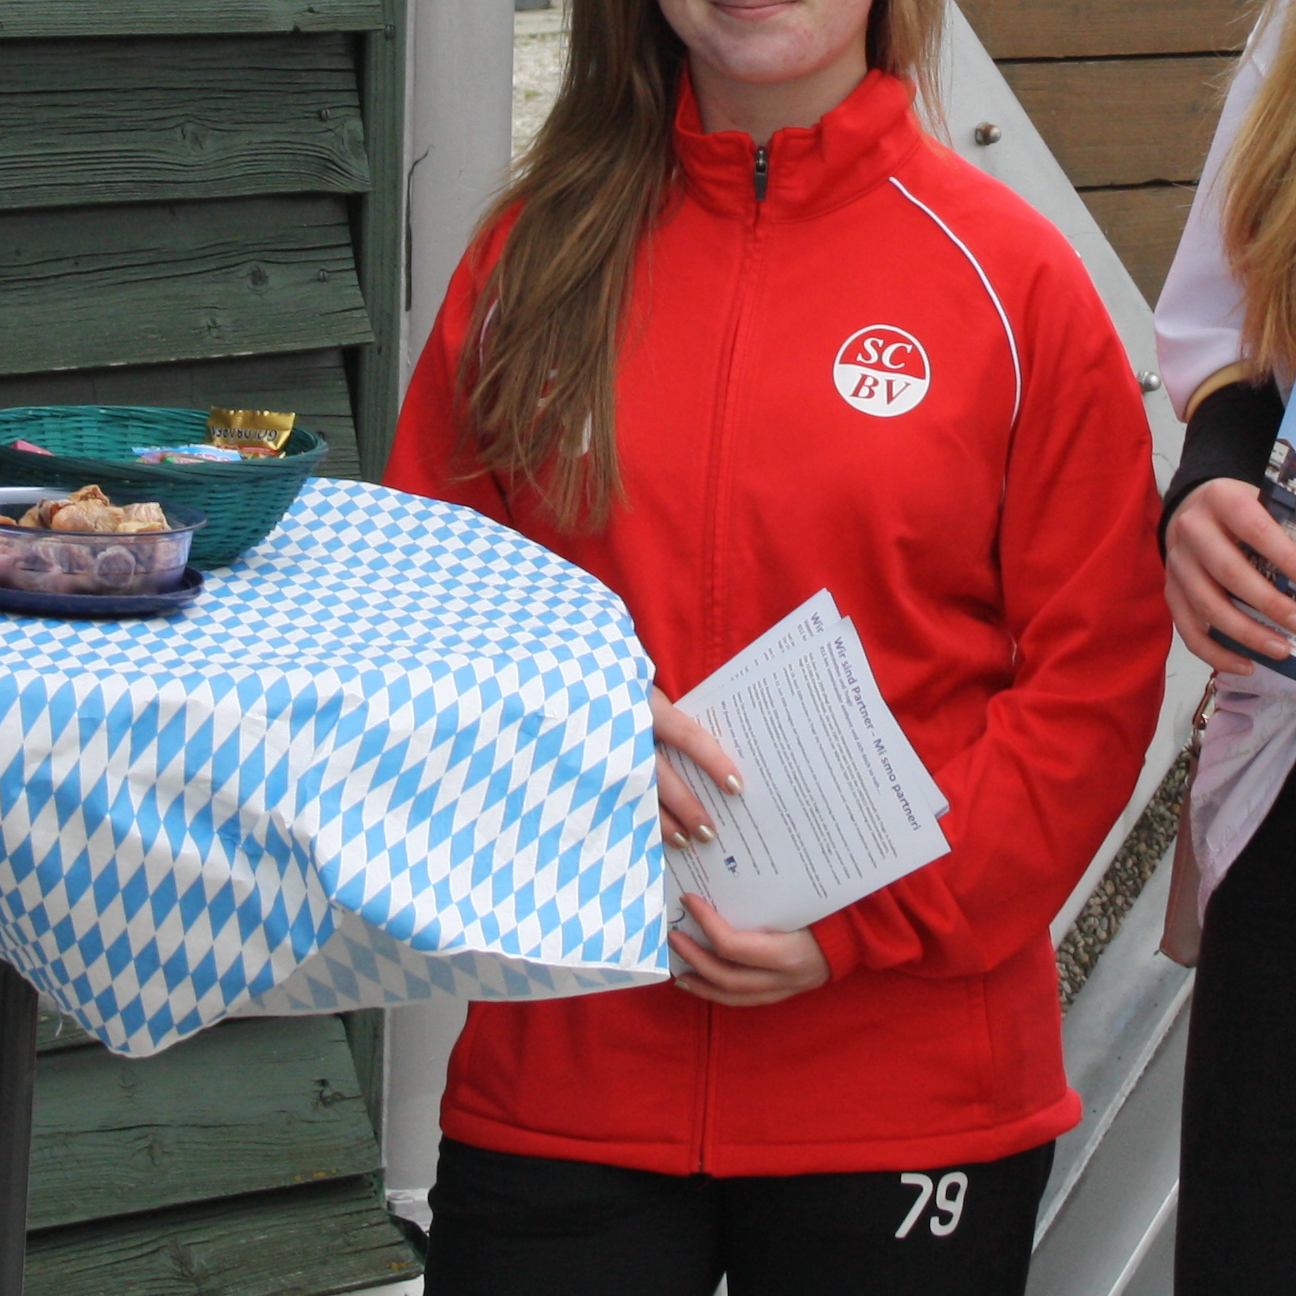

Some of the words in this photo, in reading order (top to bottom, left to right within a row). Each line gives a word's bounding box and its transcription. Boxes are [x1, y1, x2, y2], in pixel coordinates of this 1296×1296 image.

[856, 337, 913, 370] SC
[849, 372, 912, 405] BV
[811, 612, 824, 633] Wir
[834, 636, 846, 658] Wir
[840, 661, 857, 685] sind
[852, 686, 874, 729] Partner
[873, 738, 887, 756] Mi
[881, 757, 896, 782] smo
[891, 784, 921, 831] partneri
[894, 1170, 968, 1239] 79
